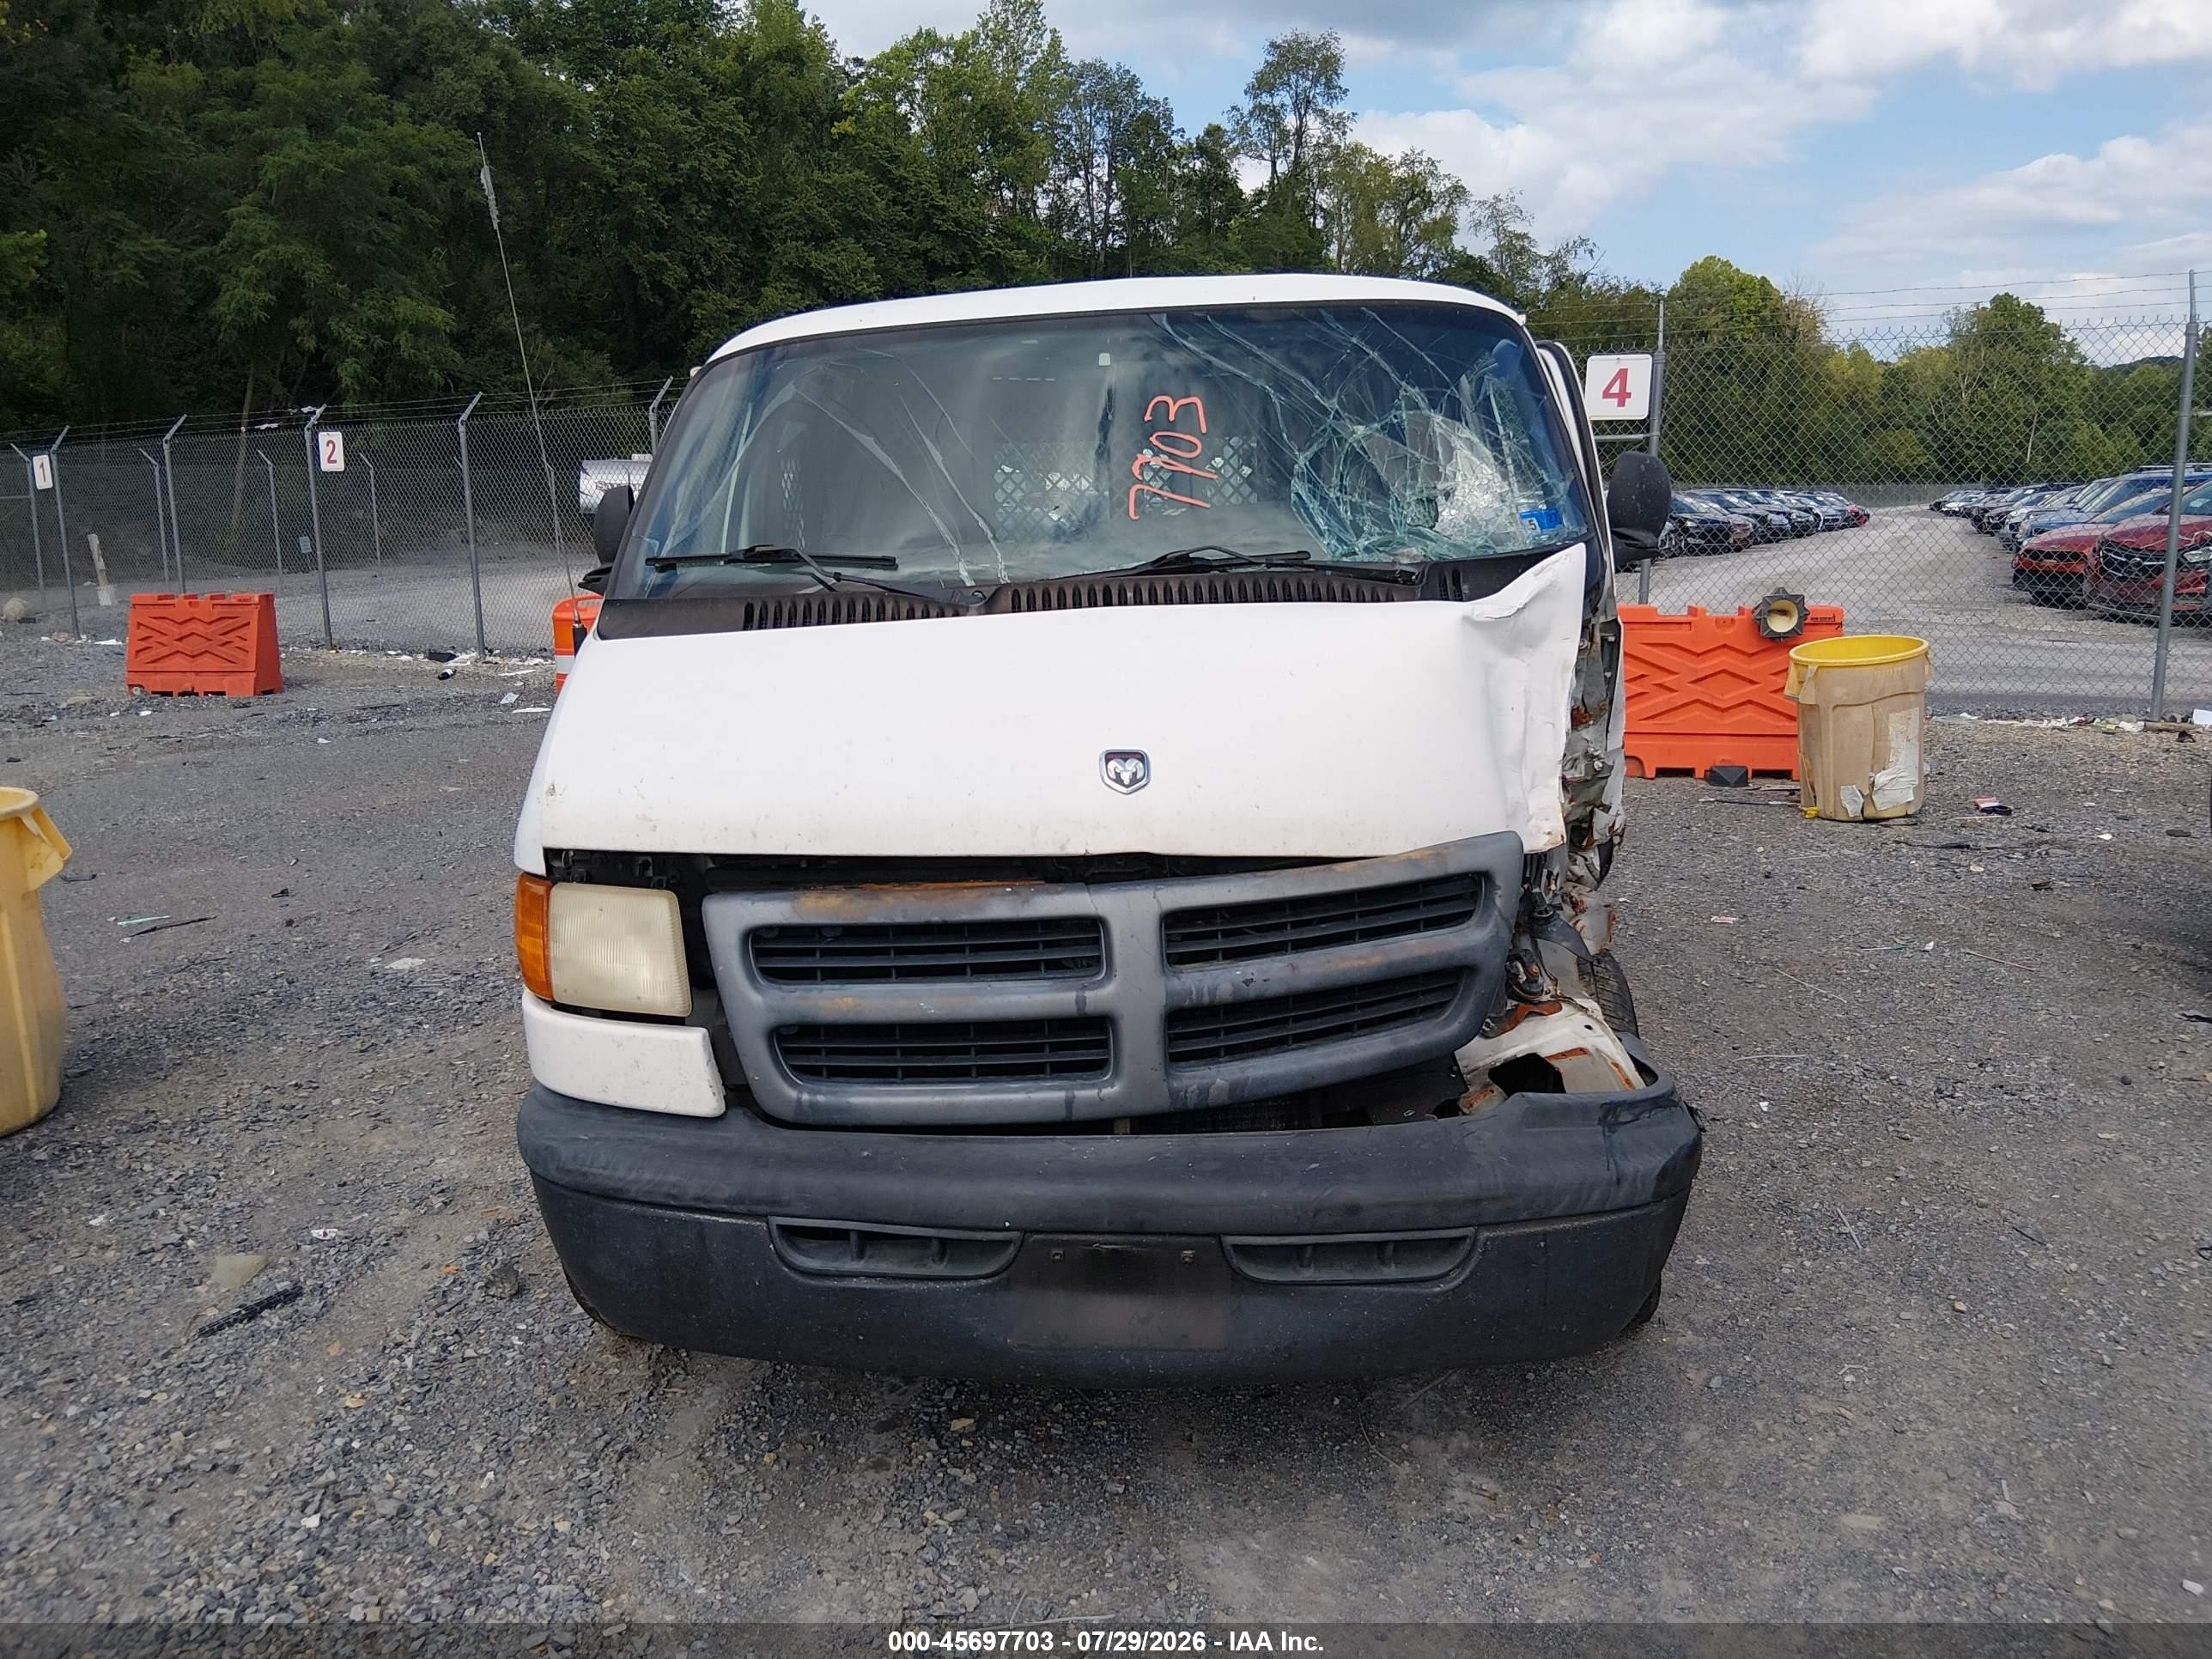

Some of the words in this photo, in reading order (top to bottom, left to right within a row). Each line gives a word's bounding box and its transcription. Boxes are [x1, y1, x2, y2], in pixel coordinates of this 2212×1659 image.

[1602, 368, 1632, 408] 4
[325, 439, 337, 465] 2
[1128, 395, 1218, 520] 7703
[39, 461, 46, 483] 1
[1528, 519, 1537, 531] 5
